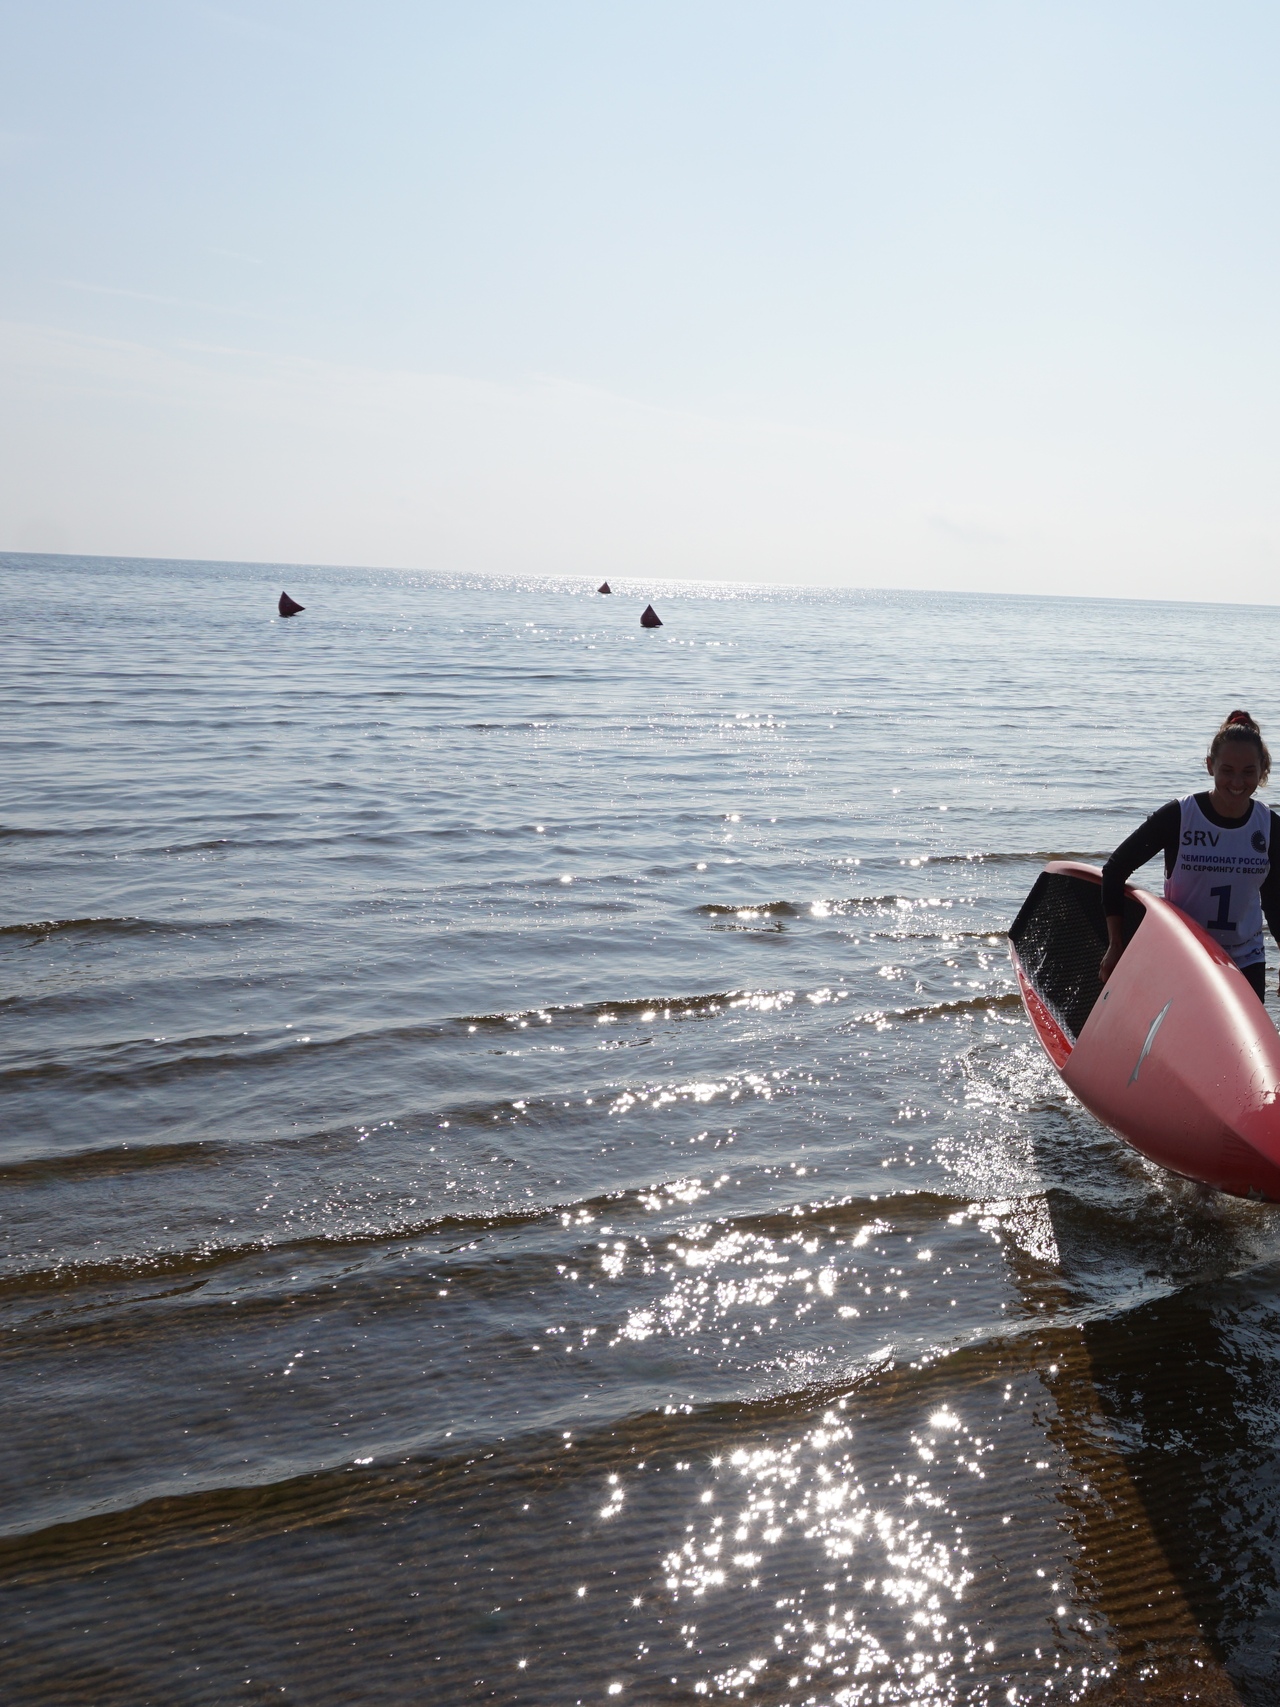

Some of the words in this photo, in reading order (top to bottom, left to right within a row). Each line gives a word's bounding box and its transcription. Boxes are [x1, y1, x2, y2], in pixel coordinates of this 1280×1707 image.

[1181, 830, 1221, 847] SRV
[1181, 854, 1237, 864] ЧЕМПИОНАТ
[1181, 863, 1192, 871] ПО
[1193, 864, 1235, 874] СЕРФИНГУ
[1206, 885, 1237, 931] 1
